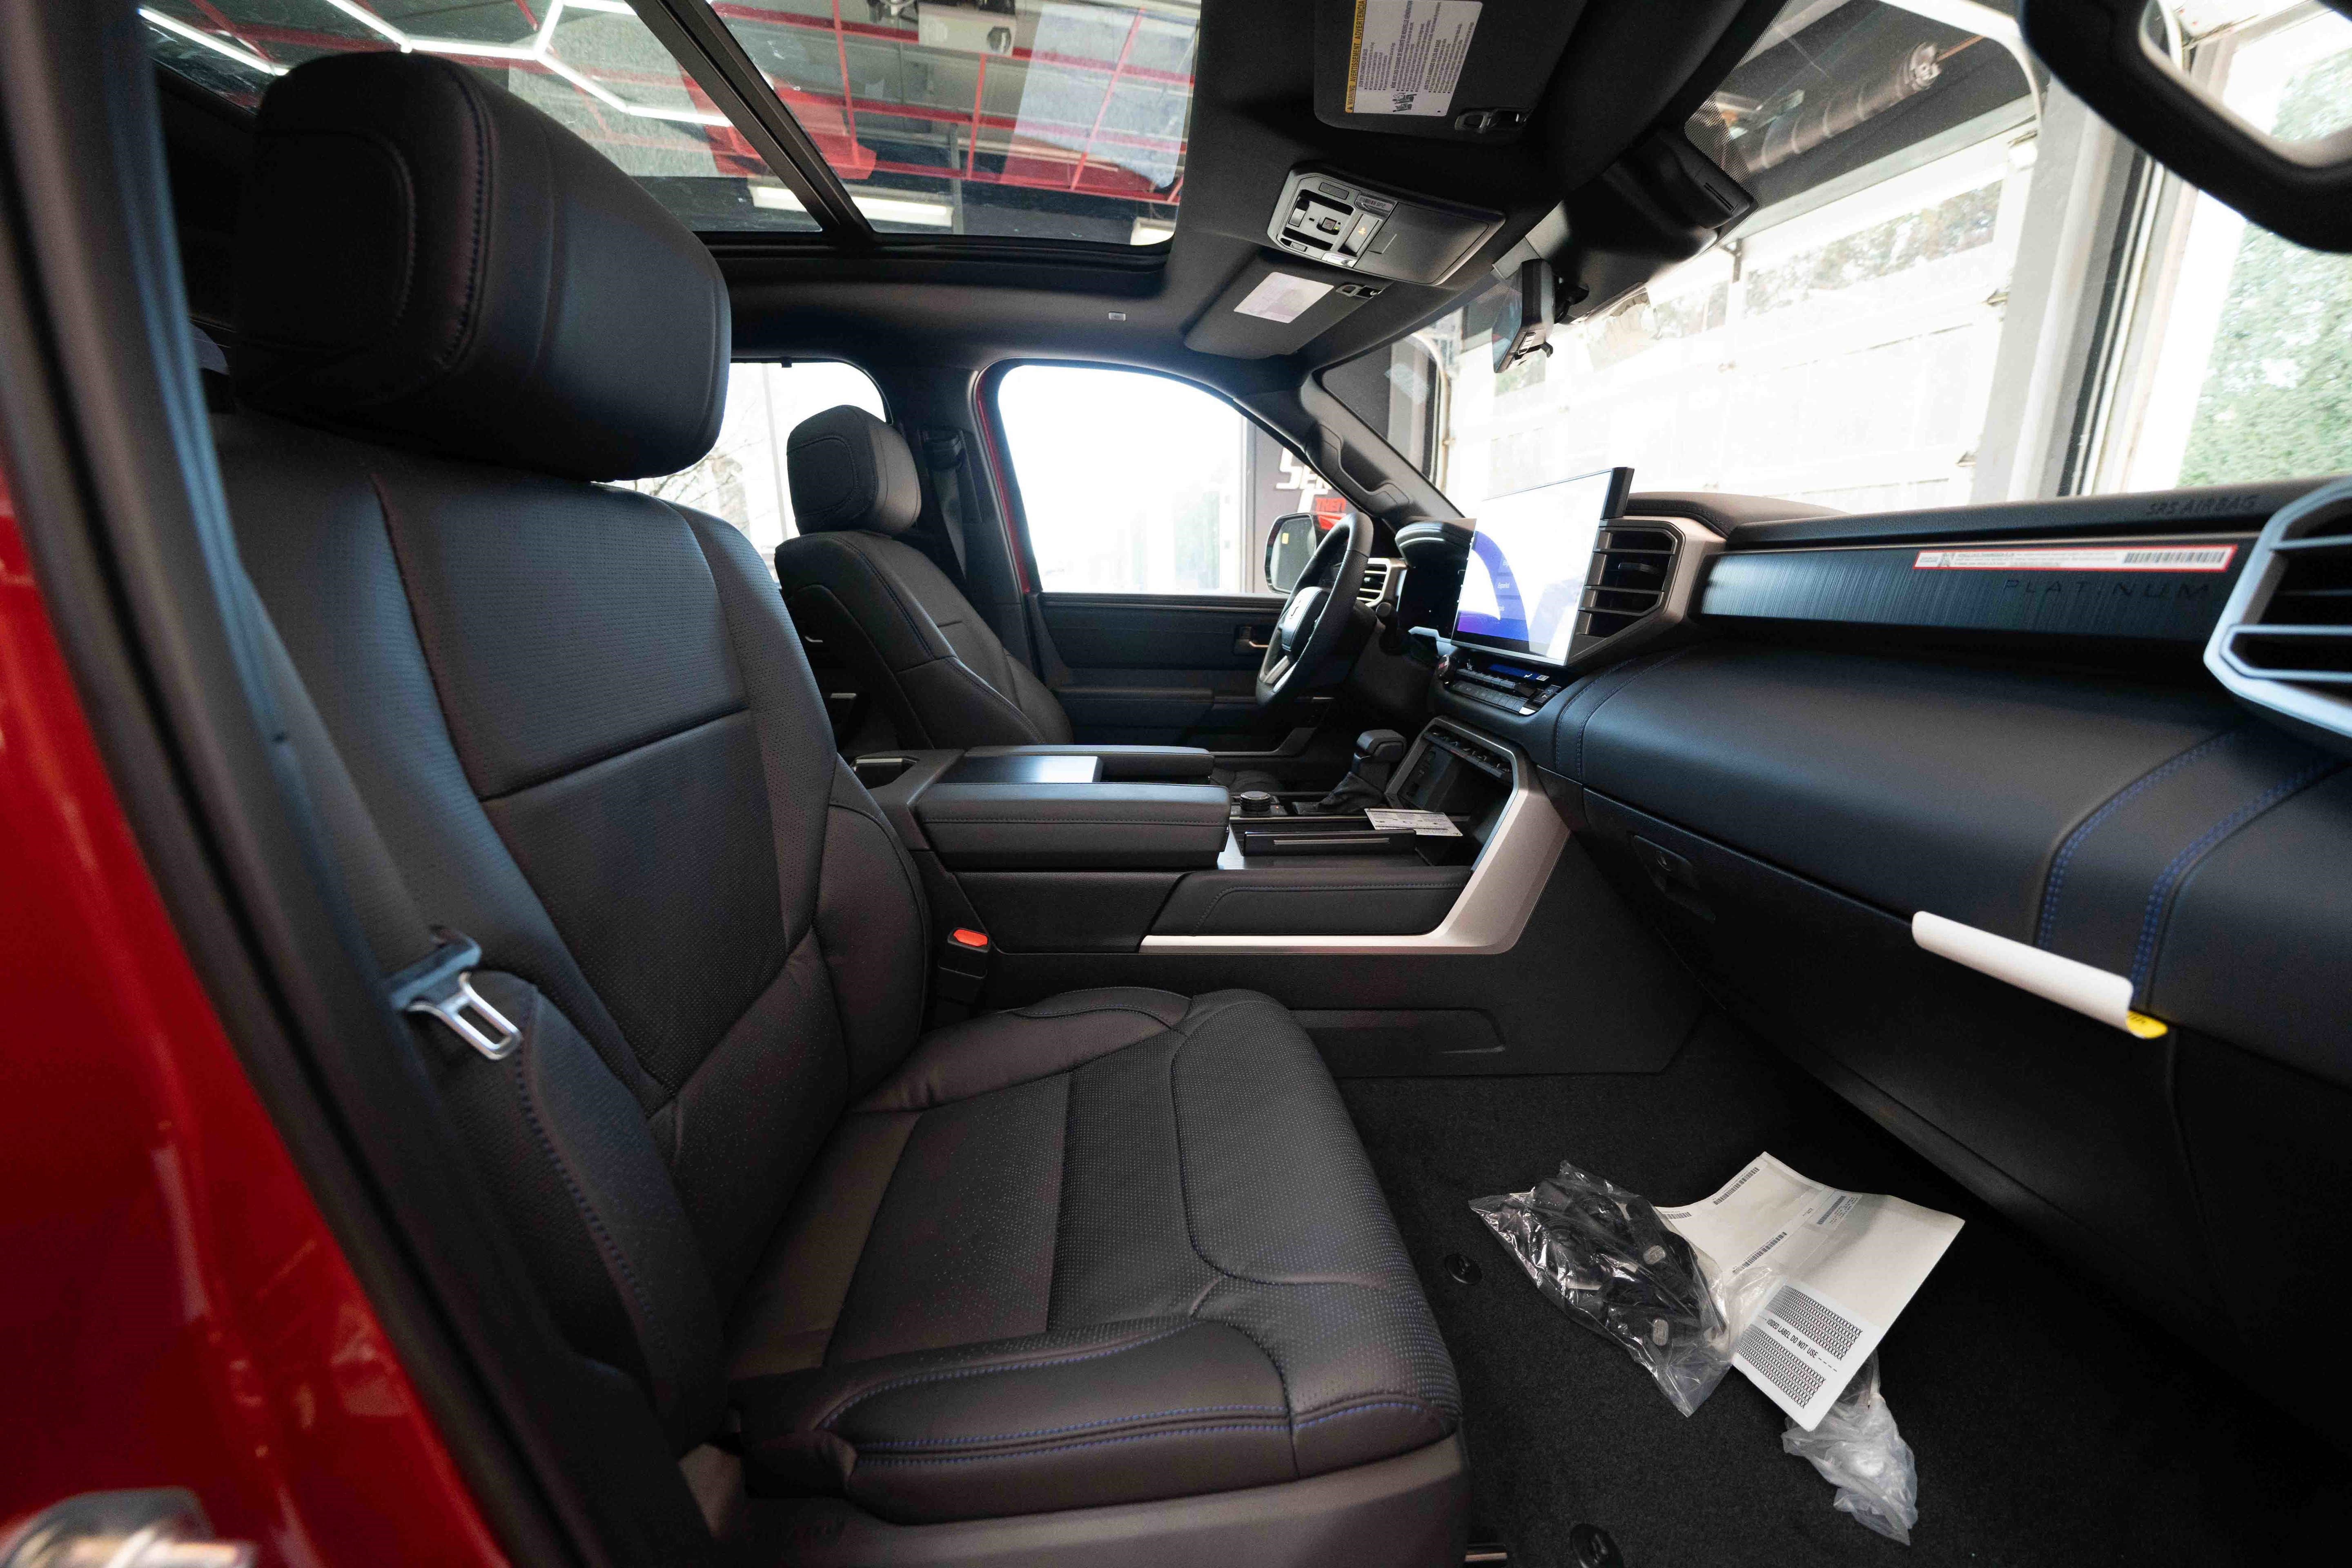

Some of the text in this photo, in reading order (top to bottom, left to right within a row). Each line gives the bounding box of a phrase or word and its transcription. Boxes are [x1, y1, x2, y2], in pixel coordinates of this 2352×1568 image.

[1354, 0, 1365, 39] ADVERTENCIA
[1350, 42, 1360, 82] AVERTISSEMENT
[2002, 579, 2209, 598] PLATINUM
[1777, 1326, 1791, 1339] LABEL
[1790, 1335, 1799, 1343] DO
[1797, 1340, 1809, 1350] NOT
[1806, 1347, 1818, 1358] USE
